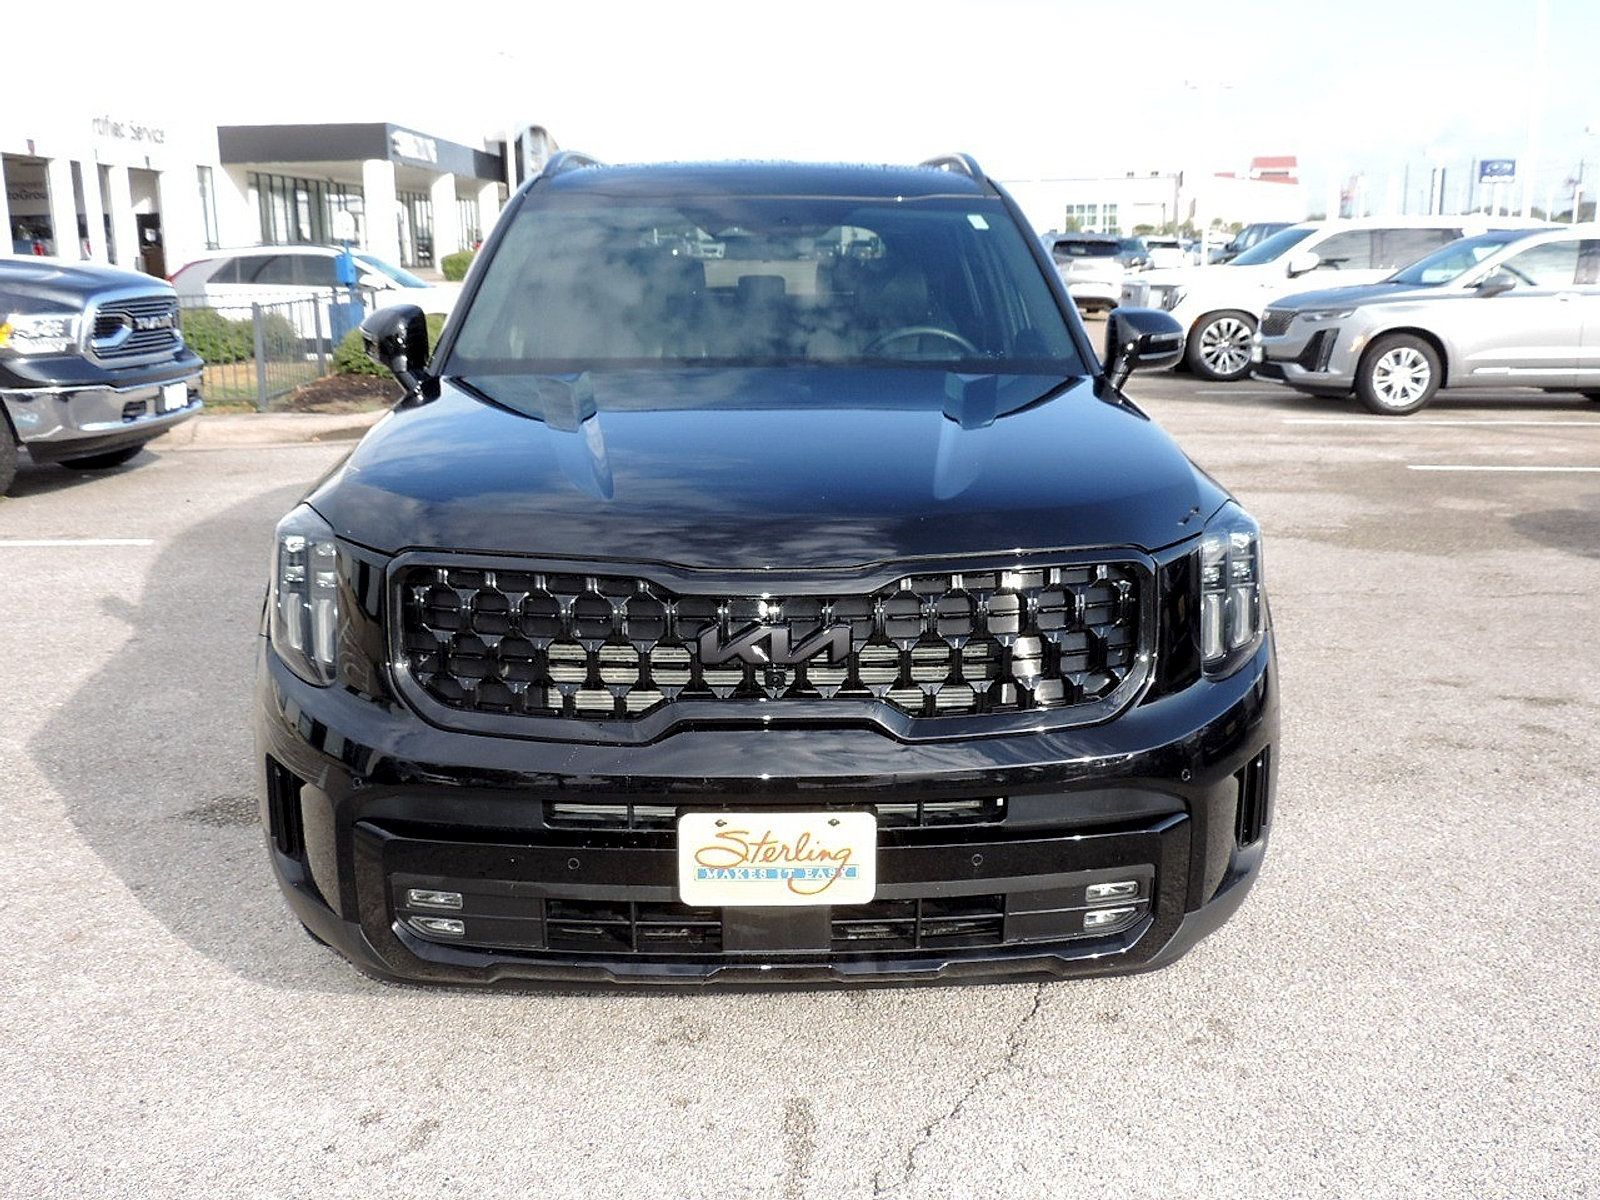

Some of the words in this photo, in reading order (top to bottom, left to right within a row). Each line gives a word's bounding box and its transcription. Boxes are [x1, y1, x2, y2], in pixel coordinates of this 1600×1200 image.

[694, 830, 852, 895] Sterling
[707, 868, 767, 880] MAKES
[777, 868, 795, 879] IT
[805, 867, 847, 879] EASY
